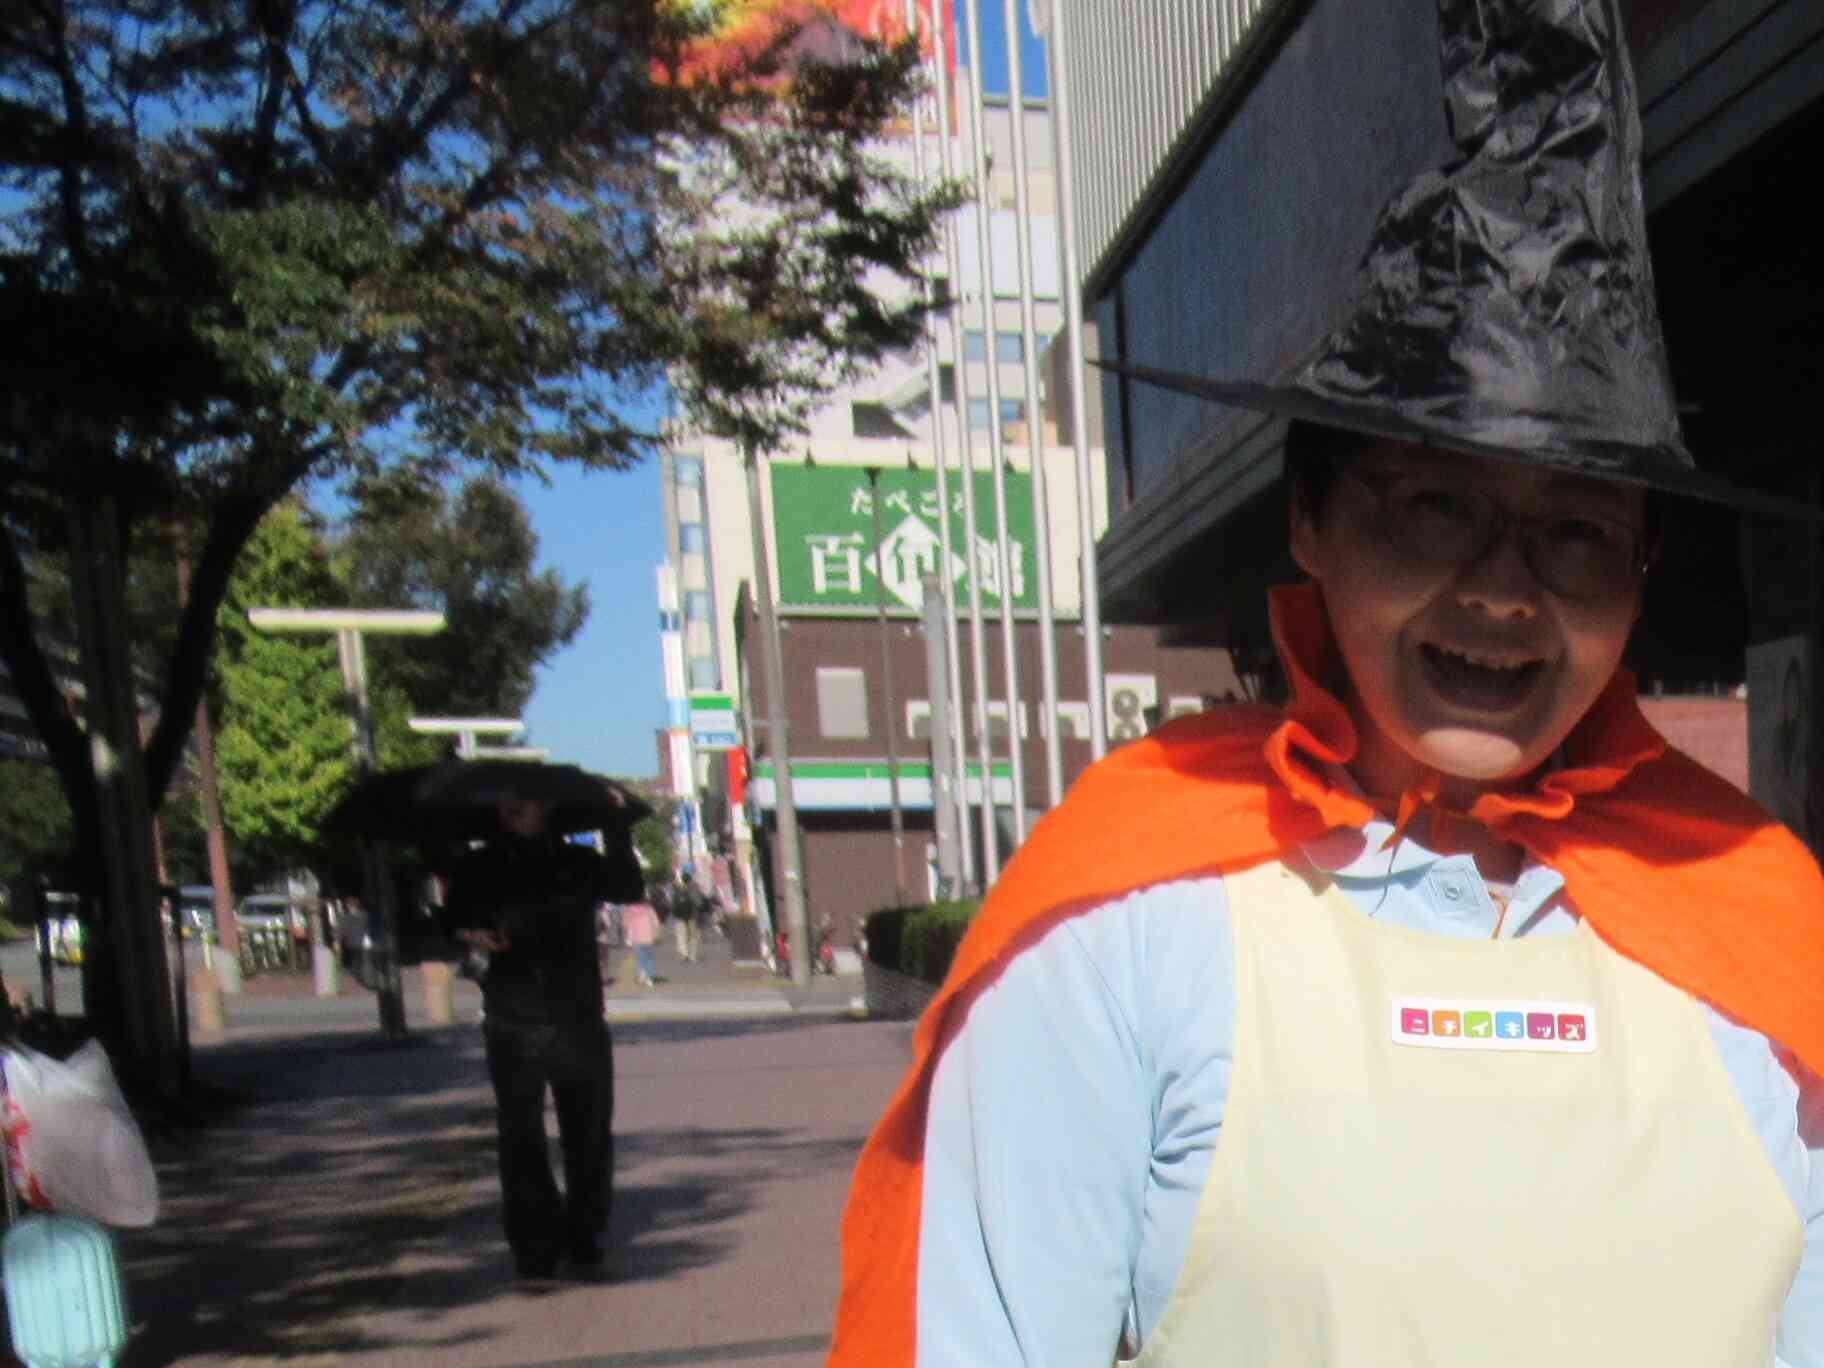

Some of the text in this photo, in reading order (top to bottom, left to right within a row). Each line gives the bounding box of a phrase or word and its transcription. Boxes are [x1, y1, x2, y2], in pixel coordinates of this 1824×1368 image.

[1402, 1011, 1586, 1041] ニチイキッズ
